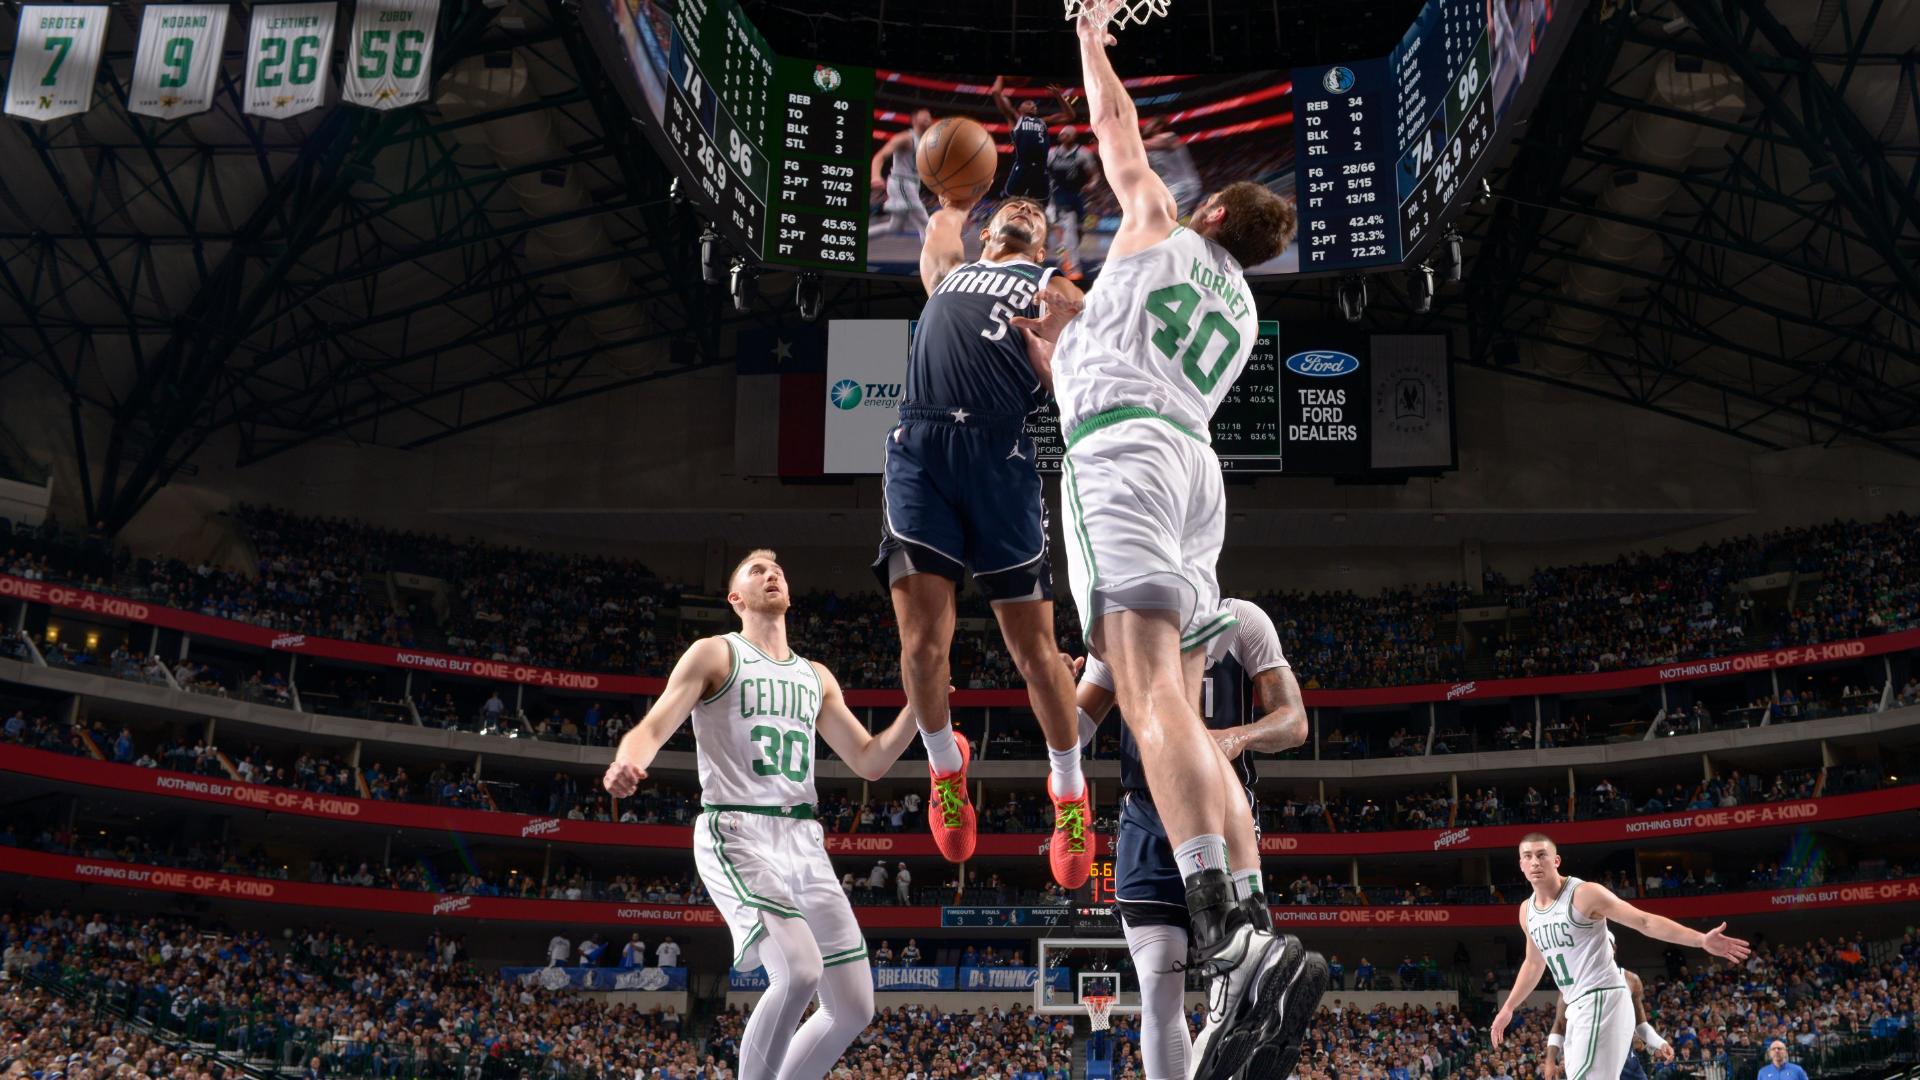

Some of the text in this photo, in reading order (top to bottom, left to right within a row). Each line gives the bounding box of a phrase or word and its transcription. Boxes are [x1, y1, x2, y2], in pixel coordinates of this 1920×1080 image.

[40, 16, 86, 30] BROTEN
[266, 16, 320, 30] LEHTINEN
[40, 36, 74, 87] 7
[159, 37, 194, 88] 9
[255, 35, 320, 88] 26
[357, 30, 425, 79] 56
[683, 53, 702, 111] 74
[1458, 57, 1479, 112] 96
[674, 97, 683, 120] TOL
[789, 94, 848, 110] REB 40
[1307, 97, 1363, 111] REB 34
[788, 108, 844, 125] TO 2
[1306, 112, 1363, 126] TO 10
[1468, 115, 1478, 134] TOL
[787, 123, 843, 139] BLK 3
[1307, 127, 1361, 141] BLK 4
[729, 128, 753, 178] 96
[786, 138, 842, 154] STL 3
[1308, 141, 1362, 155] STL 2
[1412, 129, 1434, 179] 74
[1470, 139, 1480, 160] FLS
[697, 133, 727, 190] 26.9
[785, 160, 853, 177] FG 36/79
[1309, 162, 1375, 177] FG 28/66
[1434, 136, 1463, 196] 26.9
[784, 175, 852, 192] 3-PT 17/42
[1310, 178, 1372, 192] 3-PT 5/15
[735, 186, 754, 216] TOL 4
[783, 190, 847, 206] FT 7/11
[1310, 192, 1375, 207] FT 13/18
[1408, 189, 1427, 219] TOL 3
[733, 210, 753, 239] FLS 5
[781, 213, 856, 231] FG 45.6%
[1311, 215, 1384, 230] FG 42.4%
[1410, 212, 1428, 242] FLS 3
[780, 229, 856, 246] 3-PT 40.5%
[1312, 230, 1385, 245] 3-PT 33.3%
[779, 244, 855, 261] FT 63.6%
[1312, 245, 1385, 261] FT 72.2%
[938, 270, 1038, 310] MAVS
[1190, 257, 1250, 322] KORNET
[981, 301, 1015, 342] 5
[1145, 282, 1241, 395] 40
[1300, 354, 1345, 373] Ford
[865, 384, 901, 398] TXU
[1298, 389, 1346, 405] TEXAS
[864, 399, 898, 408] energy
[1303, 407, 1342, 423] FORD
[1289, 425, 1357, 440] DEALERS
[1659, 641, 1865, 680] NOTHING BUT ONE-OF-A-KIND
[396, 652, 599, 689] NOTHING BUT ONE-OF-A-KIND
[740, 677, 817, 730] CELTICS
[750, 724, 810, 784] 30
[156, 776, 360, 816] NOTHING BUT ONE-OF-A-KIND
[1625, 803, 1818, 833] NOTHING BUT ONE-OF-A-KIND
[522, 818, 560, 838] pepper
[1434, 827, 1469, 851] pepper
[75, 863, 275, 898] NOTHING BUT ONE-OF-A-KIND
[433, 895, 471, 915] pepper
[1771, 892, 1817, 905] NOTHING
[1818, 891, 1839, 901] BUT
[617, 908, 725, 923] NOTHING BUT ONE-
[956, 916, 964, 926] 3
[986, 916, 994, 926] 3
[1043, 916, 1057, 926] 74
[1275, 910, 1450, 922] NOTHING BUT ONE-OF-A-KIND
[877, 968, 939, 988] BREAKERS
[1547, 953, 1575, 987] 11
[731, 978, 767, 987] ULTRA
